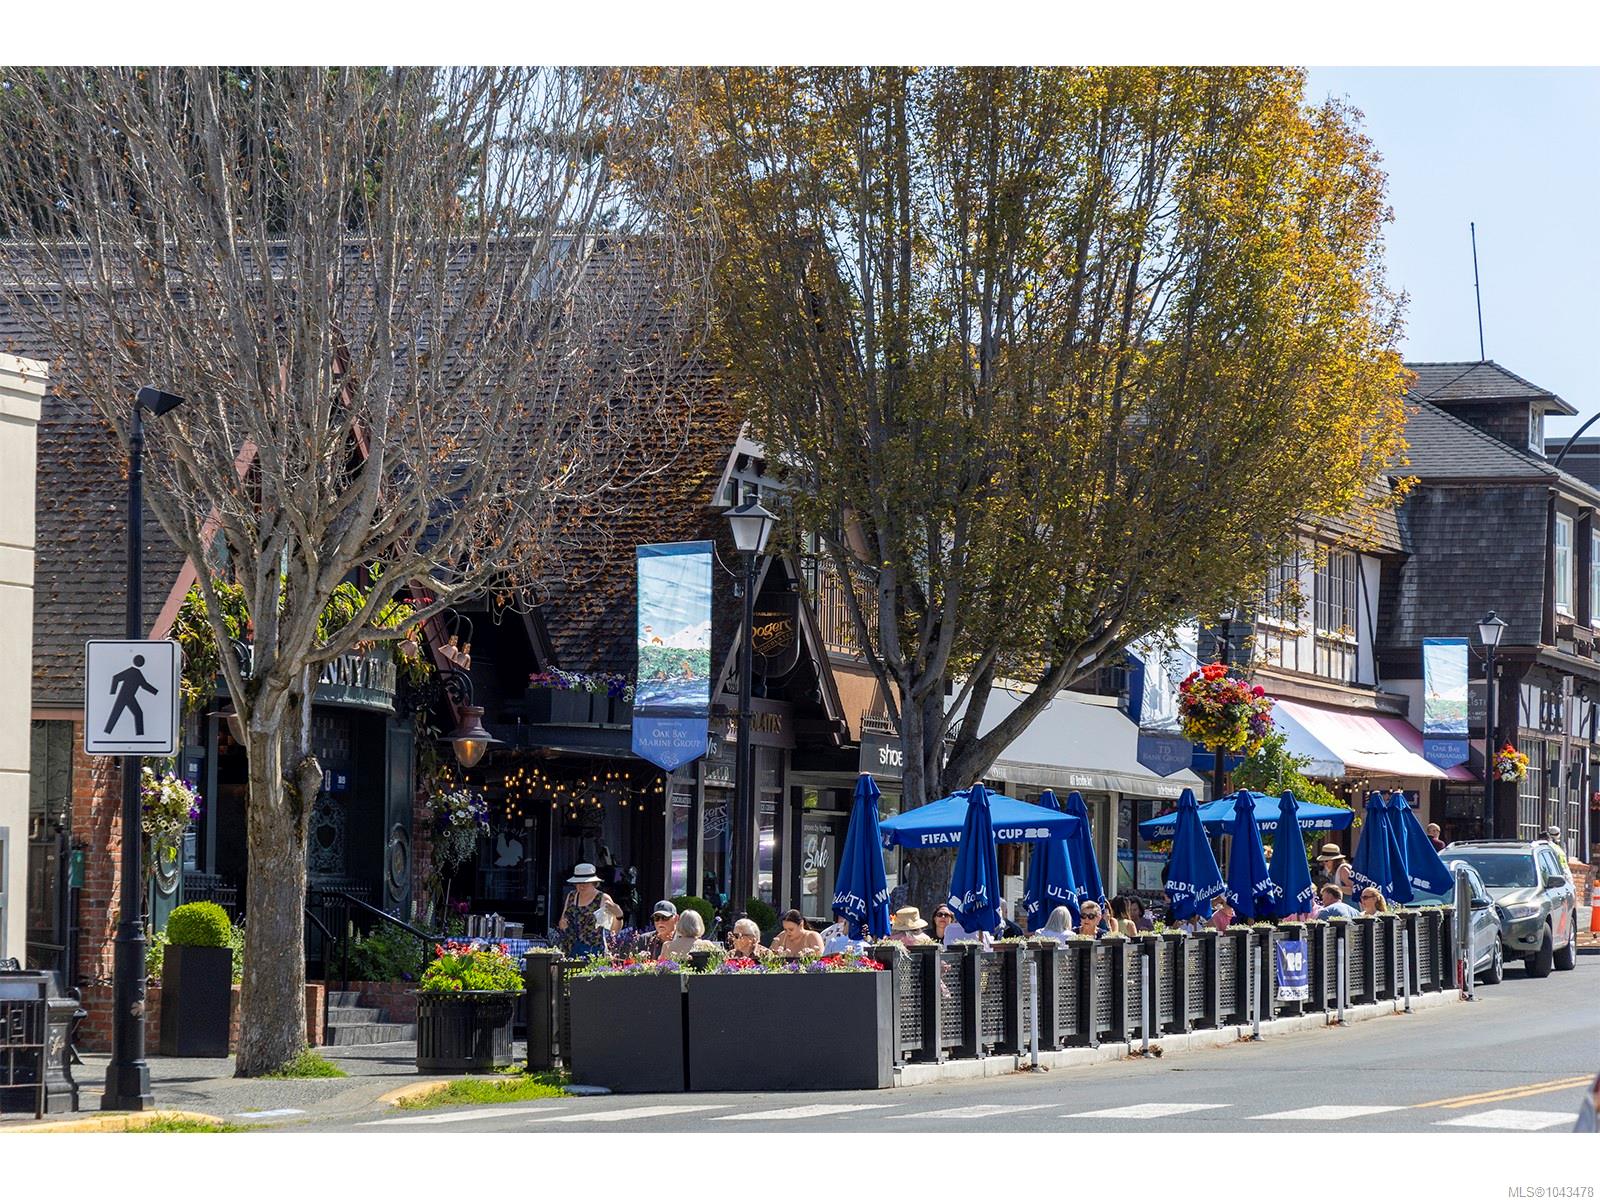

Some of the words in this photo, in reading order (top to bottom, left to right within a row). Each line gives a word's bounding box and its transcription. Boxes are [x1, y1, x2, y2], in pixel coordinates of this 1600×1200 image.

[652, 729, 670, 738] OAK
[672, 729, 688, 738] BAY
[639, 739, 671, 748] MARINE
[1159, 745, 1172, 754] TD
[921, 833, 949, 845] FIFA
[998, 829, 1023, 840] CUP
